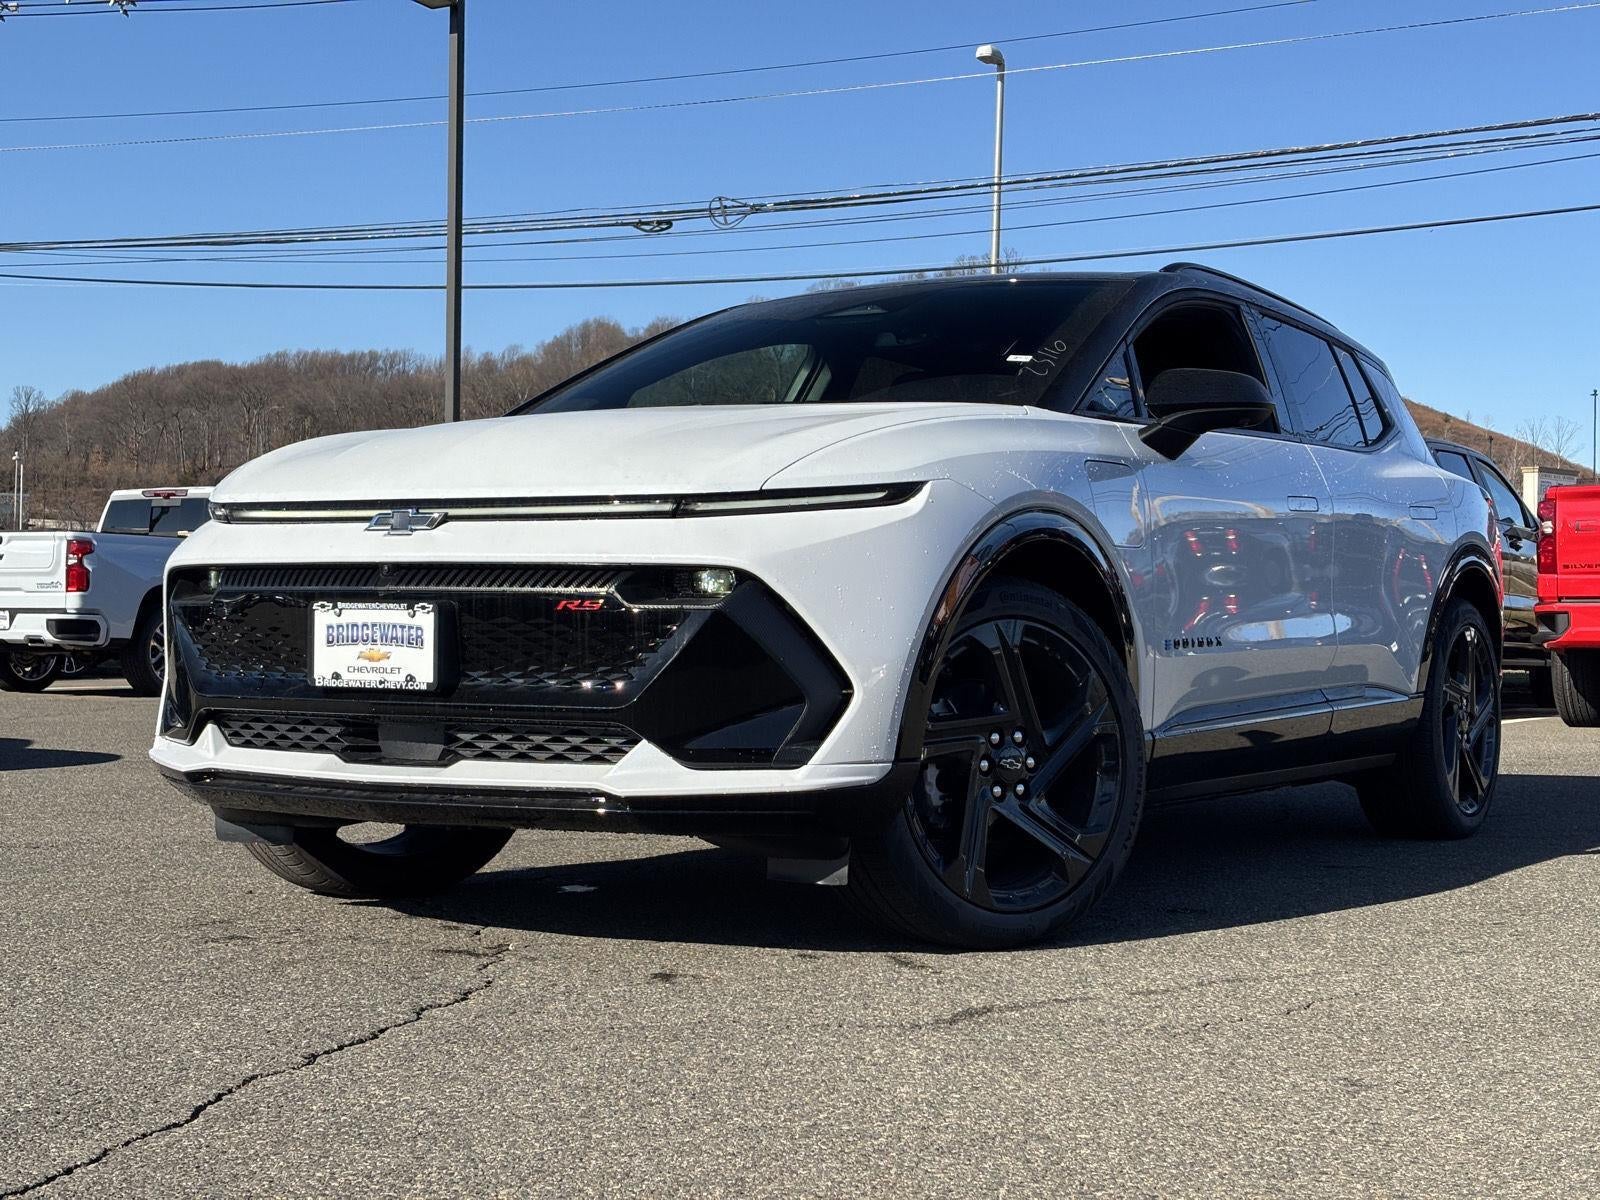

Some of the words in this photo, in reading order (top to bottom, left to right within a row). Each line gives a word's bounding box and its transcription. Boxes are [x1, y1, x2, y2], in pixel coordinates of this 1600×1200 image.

[556, 599, 604, 611] RS
[326, 622, 425, 650] BRIDGEWATER
[347, 666, 402, 675] CHEVROLET
